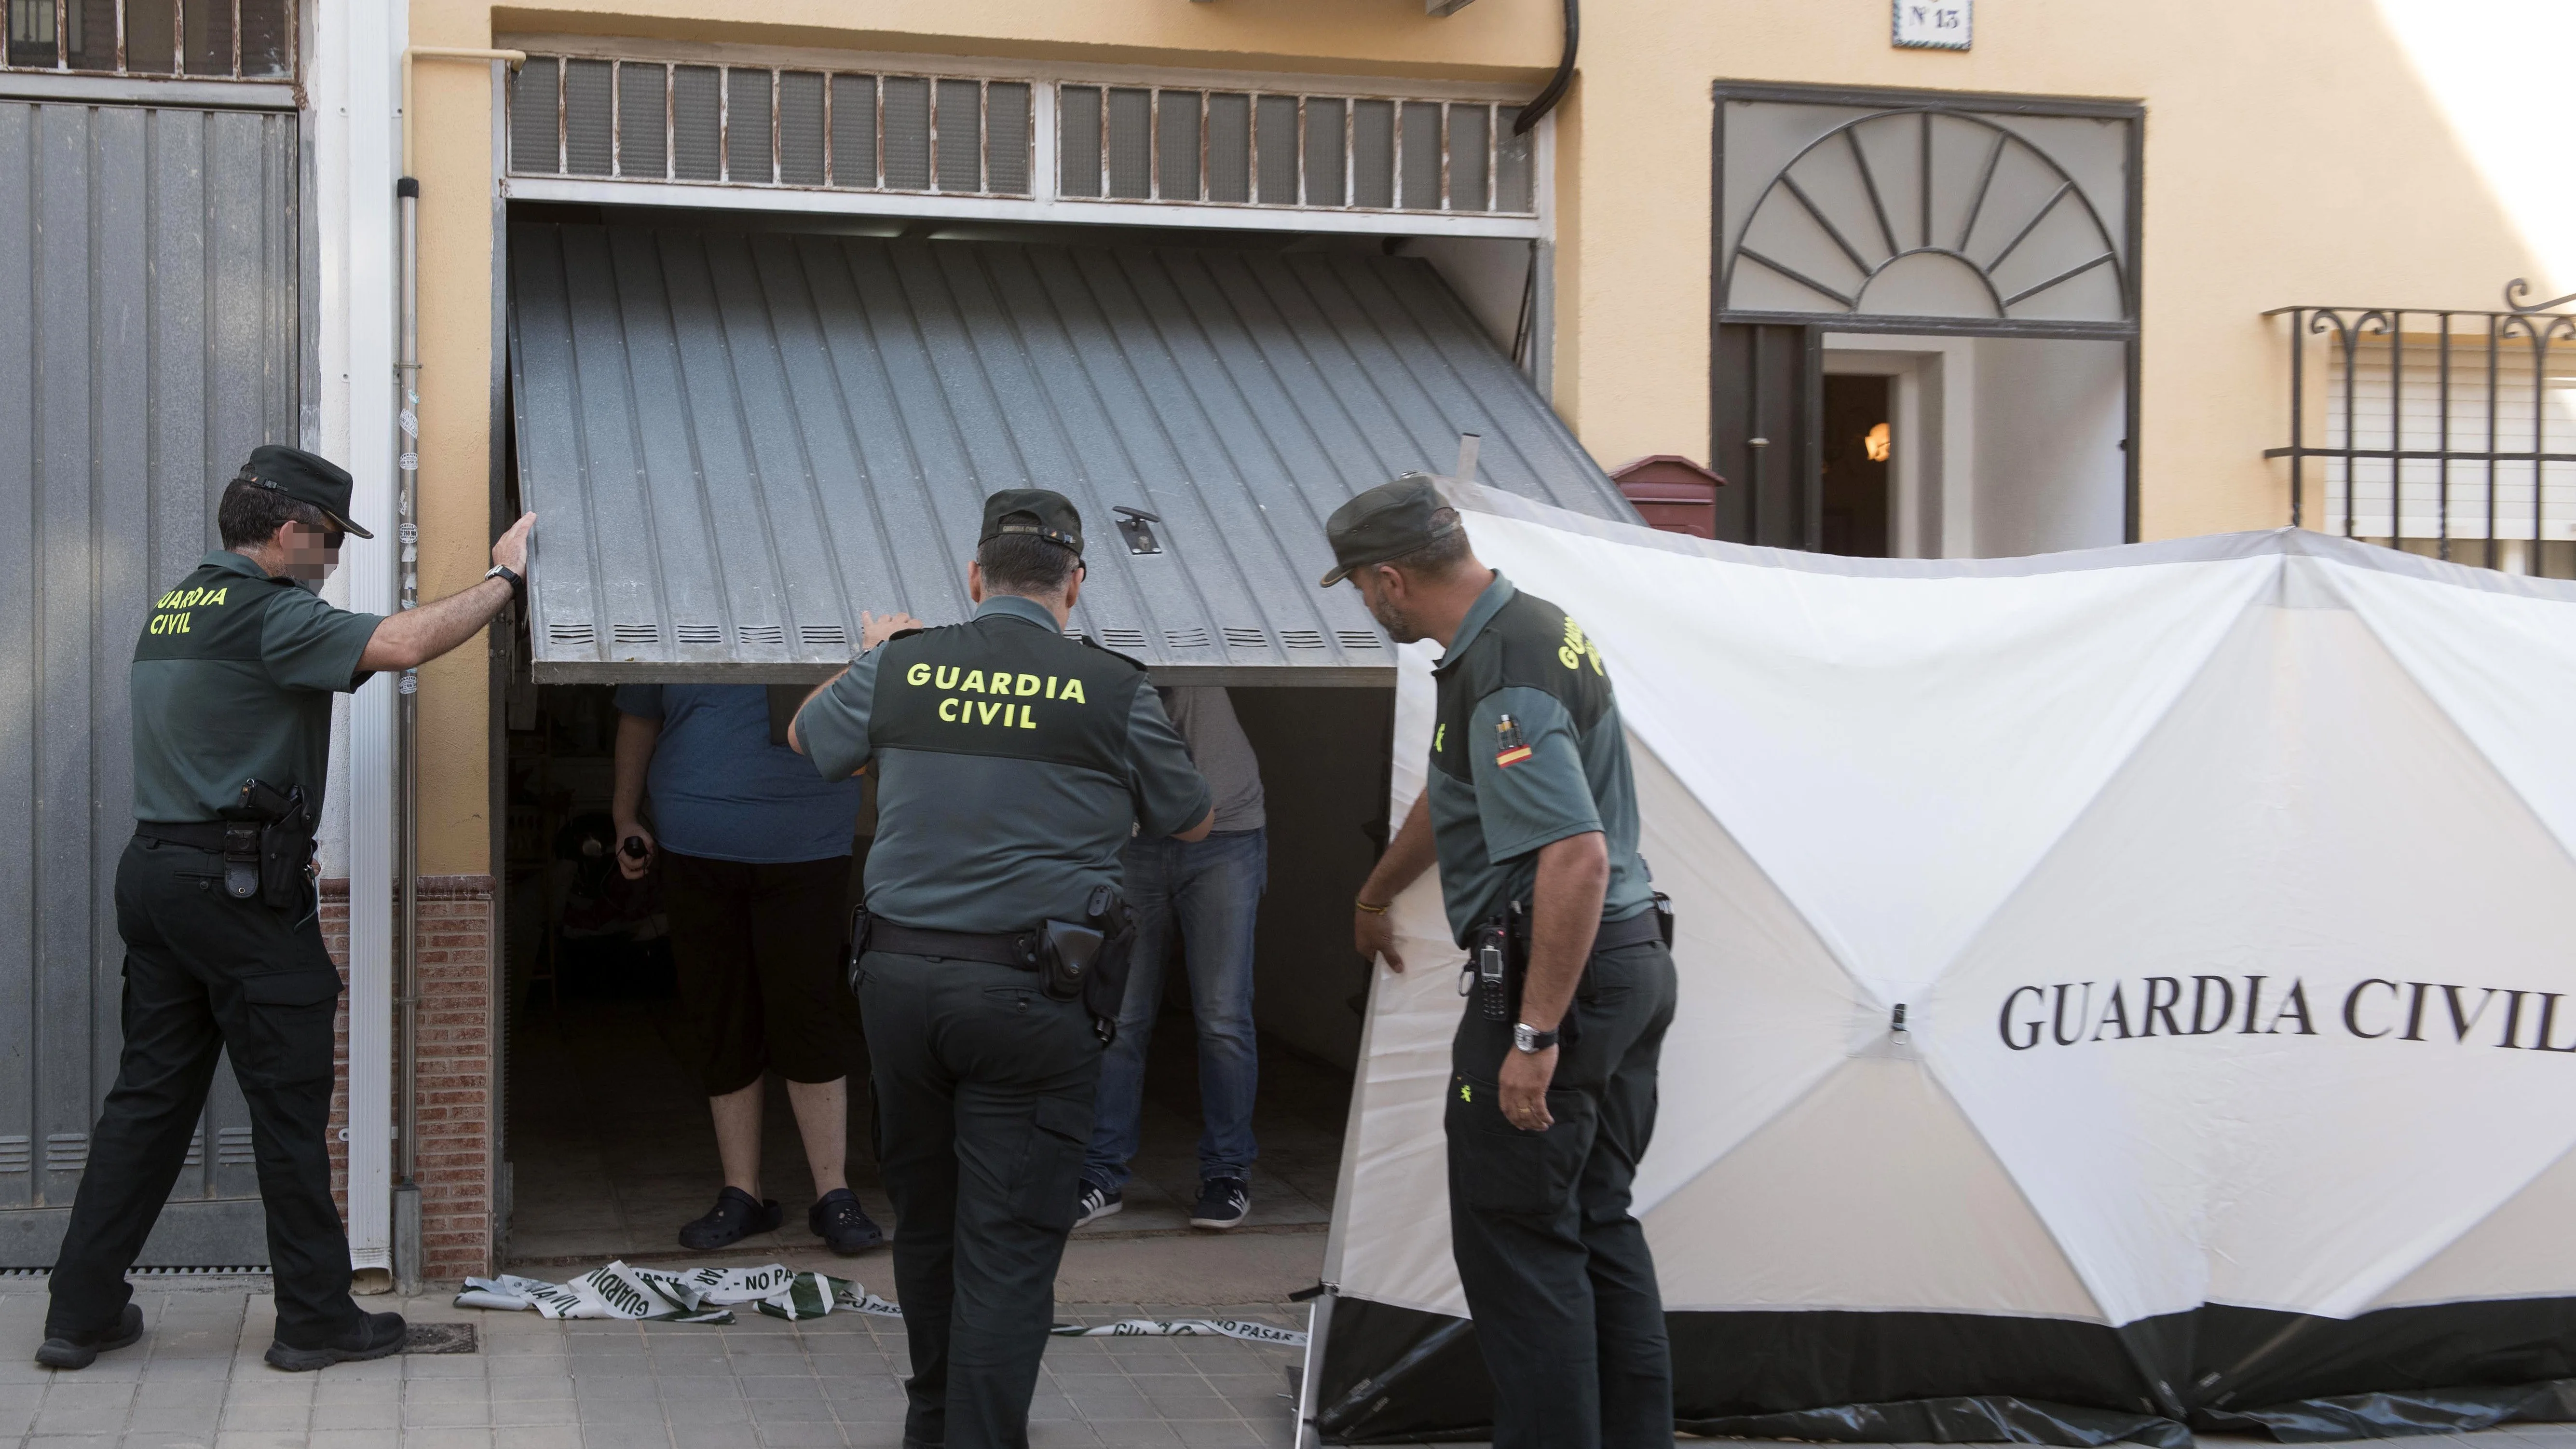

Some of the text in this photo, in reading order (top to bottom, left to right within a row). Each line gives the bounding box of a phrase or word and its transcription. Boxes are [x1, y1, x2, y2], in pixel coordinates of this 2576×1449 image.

[153, 587, 228, 609] UARDIA
[150, 612, 191, 635] CIVIL
[907, 663, 1086, 704] GUARDIA
[939, 697, 1037, 729] CIVIL
[1998, 974, 2576, 1053] GUARDIA CIVIL
[745, 1271, 770, 1290] NO
[774, 1268, 794, 1286] PA
